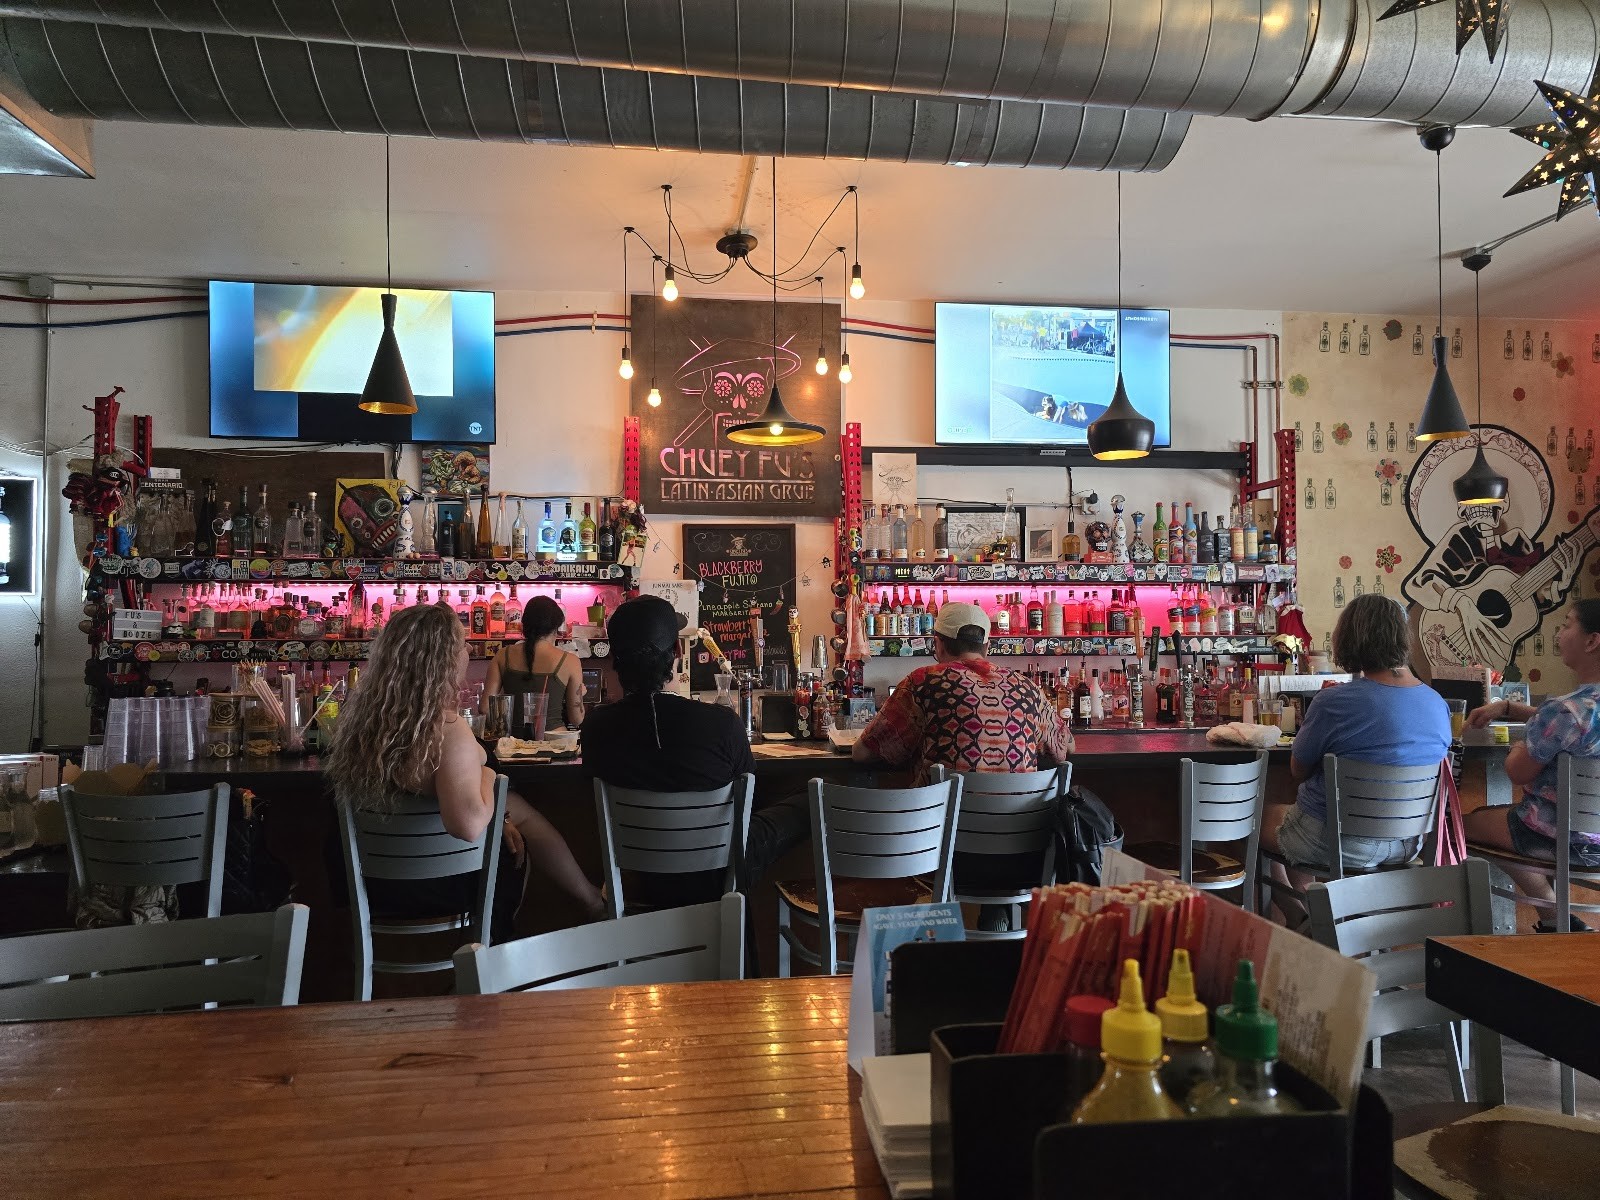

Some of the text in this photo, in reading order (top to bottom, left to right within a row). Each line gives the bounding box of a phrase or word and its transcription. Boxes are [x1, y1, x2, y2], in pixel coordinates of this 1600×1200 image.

[660, 448, 815, 479] CHUEY FU'S
[769, 484, 815, 500] GRUB
[699, 559, 763, 578] BLACKBERRY
[123, 630, 152, 639] BOOZE
